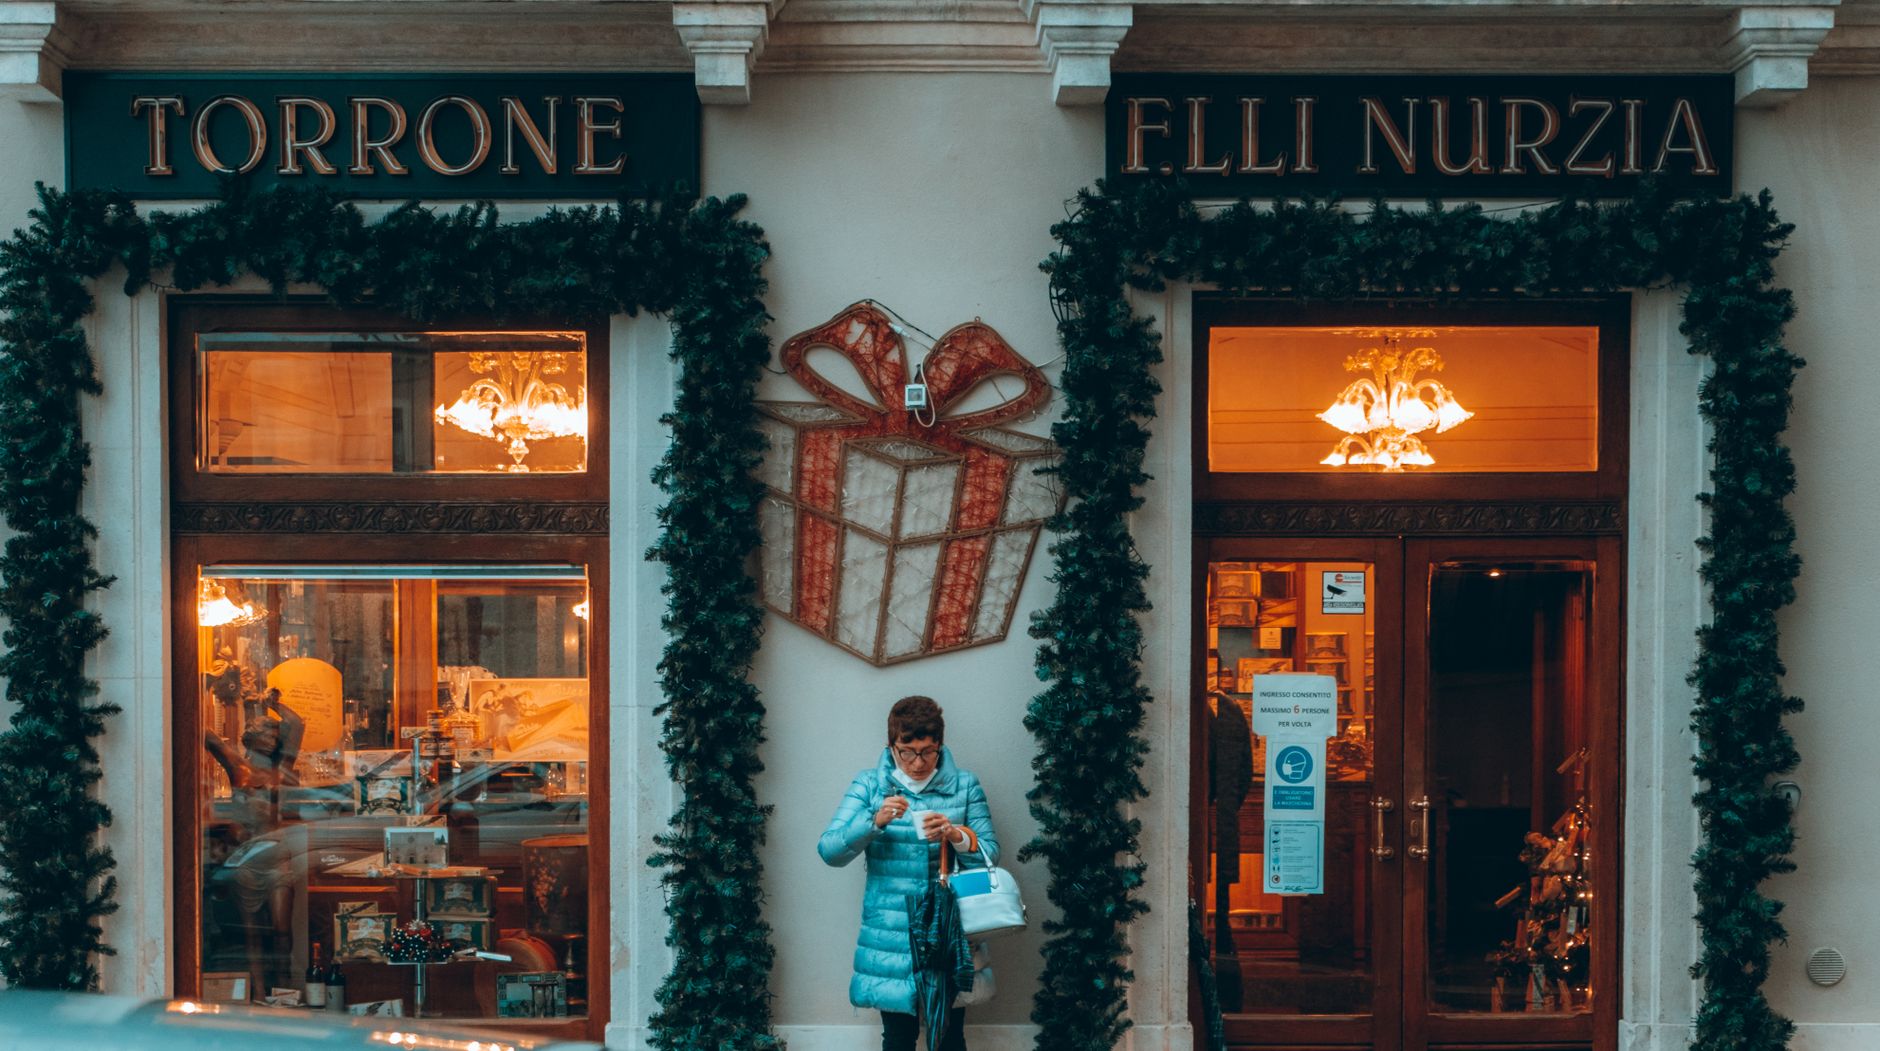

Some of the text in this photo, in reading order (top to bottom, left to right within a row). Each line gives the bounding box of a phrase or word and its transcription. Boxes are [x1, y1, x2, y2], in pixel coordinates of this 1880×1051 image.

[130, 94, 627, 175] TORRONE
[1121, 94, 1719, 178] F.LLI NURZIA
[1293, 704, 1300, 714] 6
